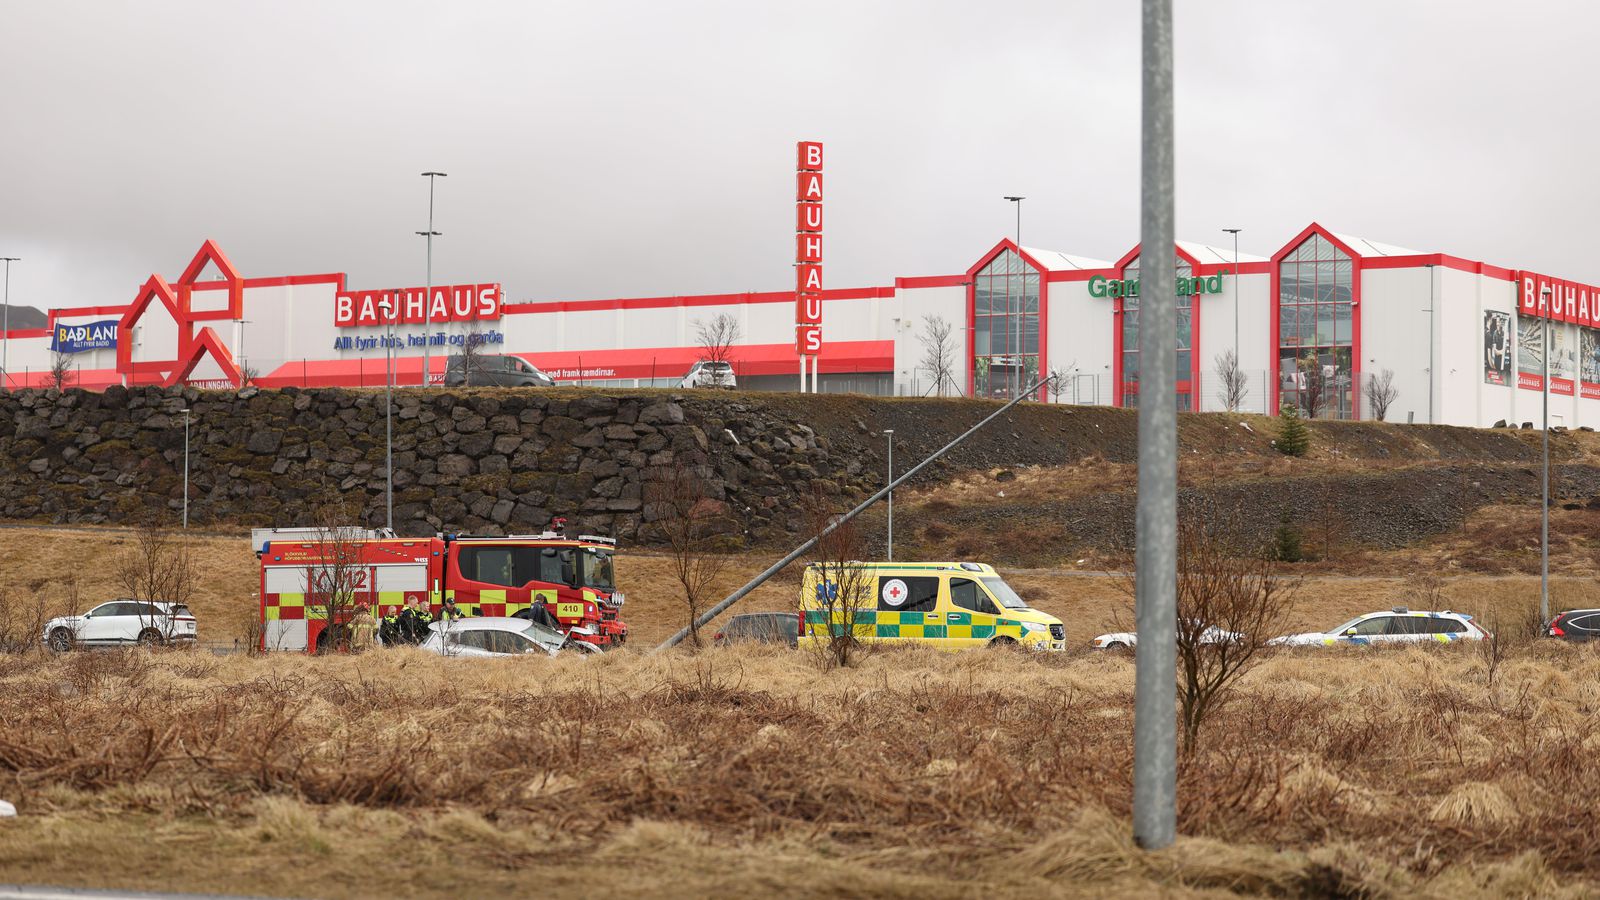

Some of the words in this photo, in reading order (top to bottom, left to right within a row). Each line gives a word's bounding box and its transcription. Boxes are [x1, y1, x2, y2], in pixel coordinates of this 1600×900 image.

[806, 145, 822, 351] BAUHAUS
[1088, 270, 1223, 298] Garand
[337, 288, 496, 322] BAUHAUS
[334, 336, 352, 350] Allt
[355, 335, 378, 350] fyrir
[448, 333, 464, 347] og
[562, 605, 579, 613] 410
